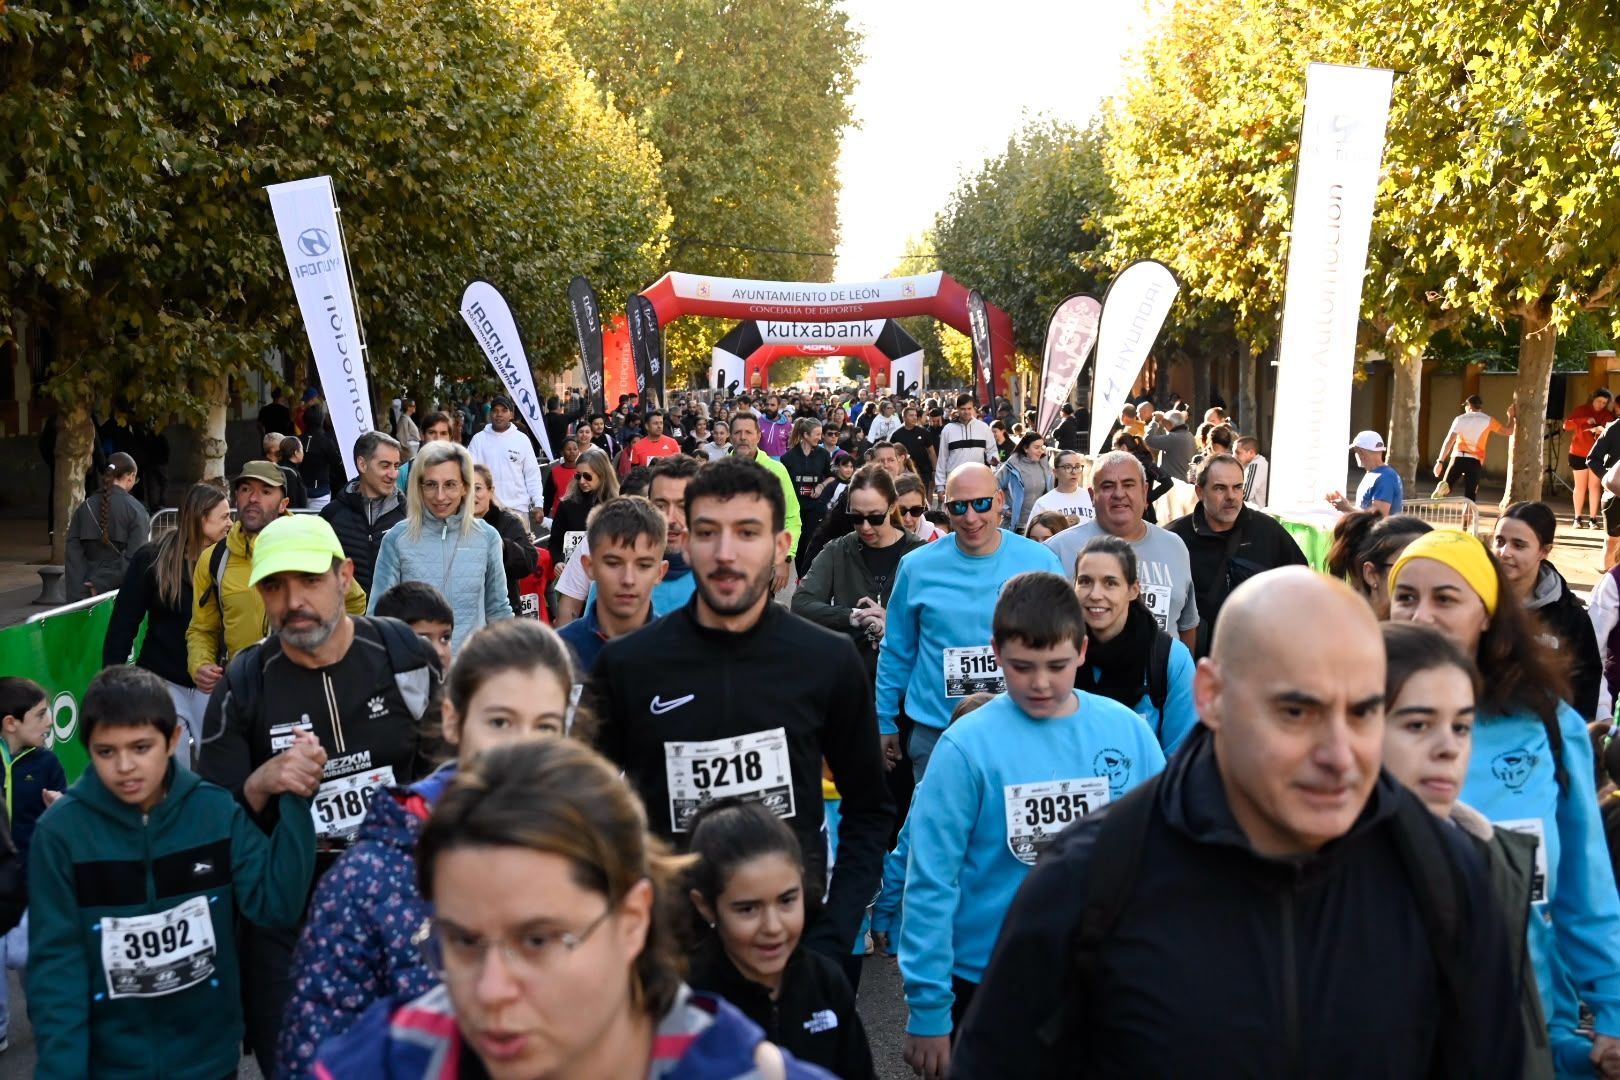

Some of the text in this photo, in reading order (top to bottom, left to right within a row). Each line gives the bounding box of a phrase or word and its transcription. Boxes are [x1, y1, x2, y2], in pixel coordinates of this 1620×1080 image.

[732, 288, 880, 302] AYUNTAMIENTO DE LEÓN
[750, 304, 863, 315] CONCEJALÍA DE DEPORTES
[767, 320, 874, 338] kutxabank
[1115, 282, 1163, 370] HYUNDAI
[1057, 506, 1093, 518] OWNIE
[960, 655, 998, 673] 5115
[691, 750, 762, 789] 5218
[1025, 794, 1089, 826] 3935
[124, 919, 193, 960] 3992
